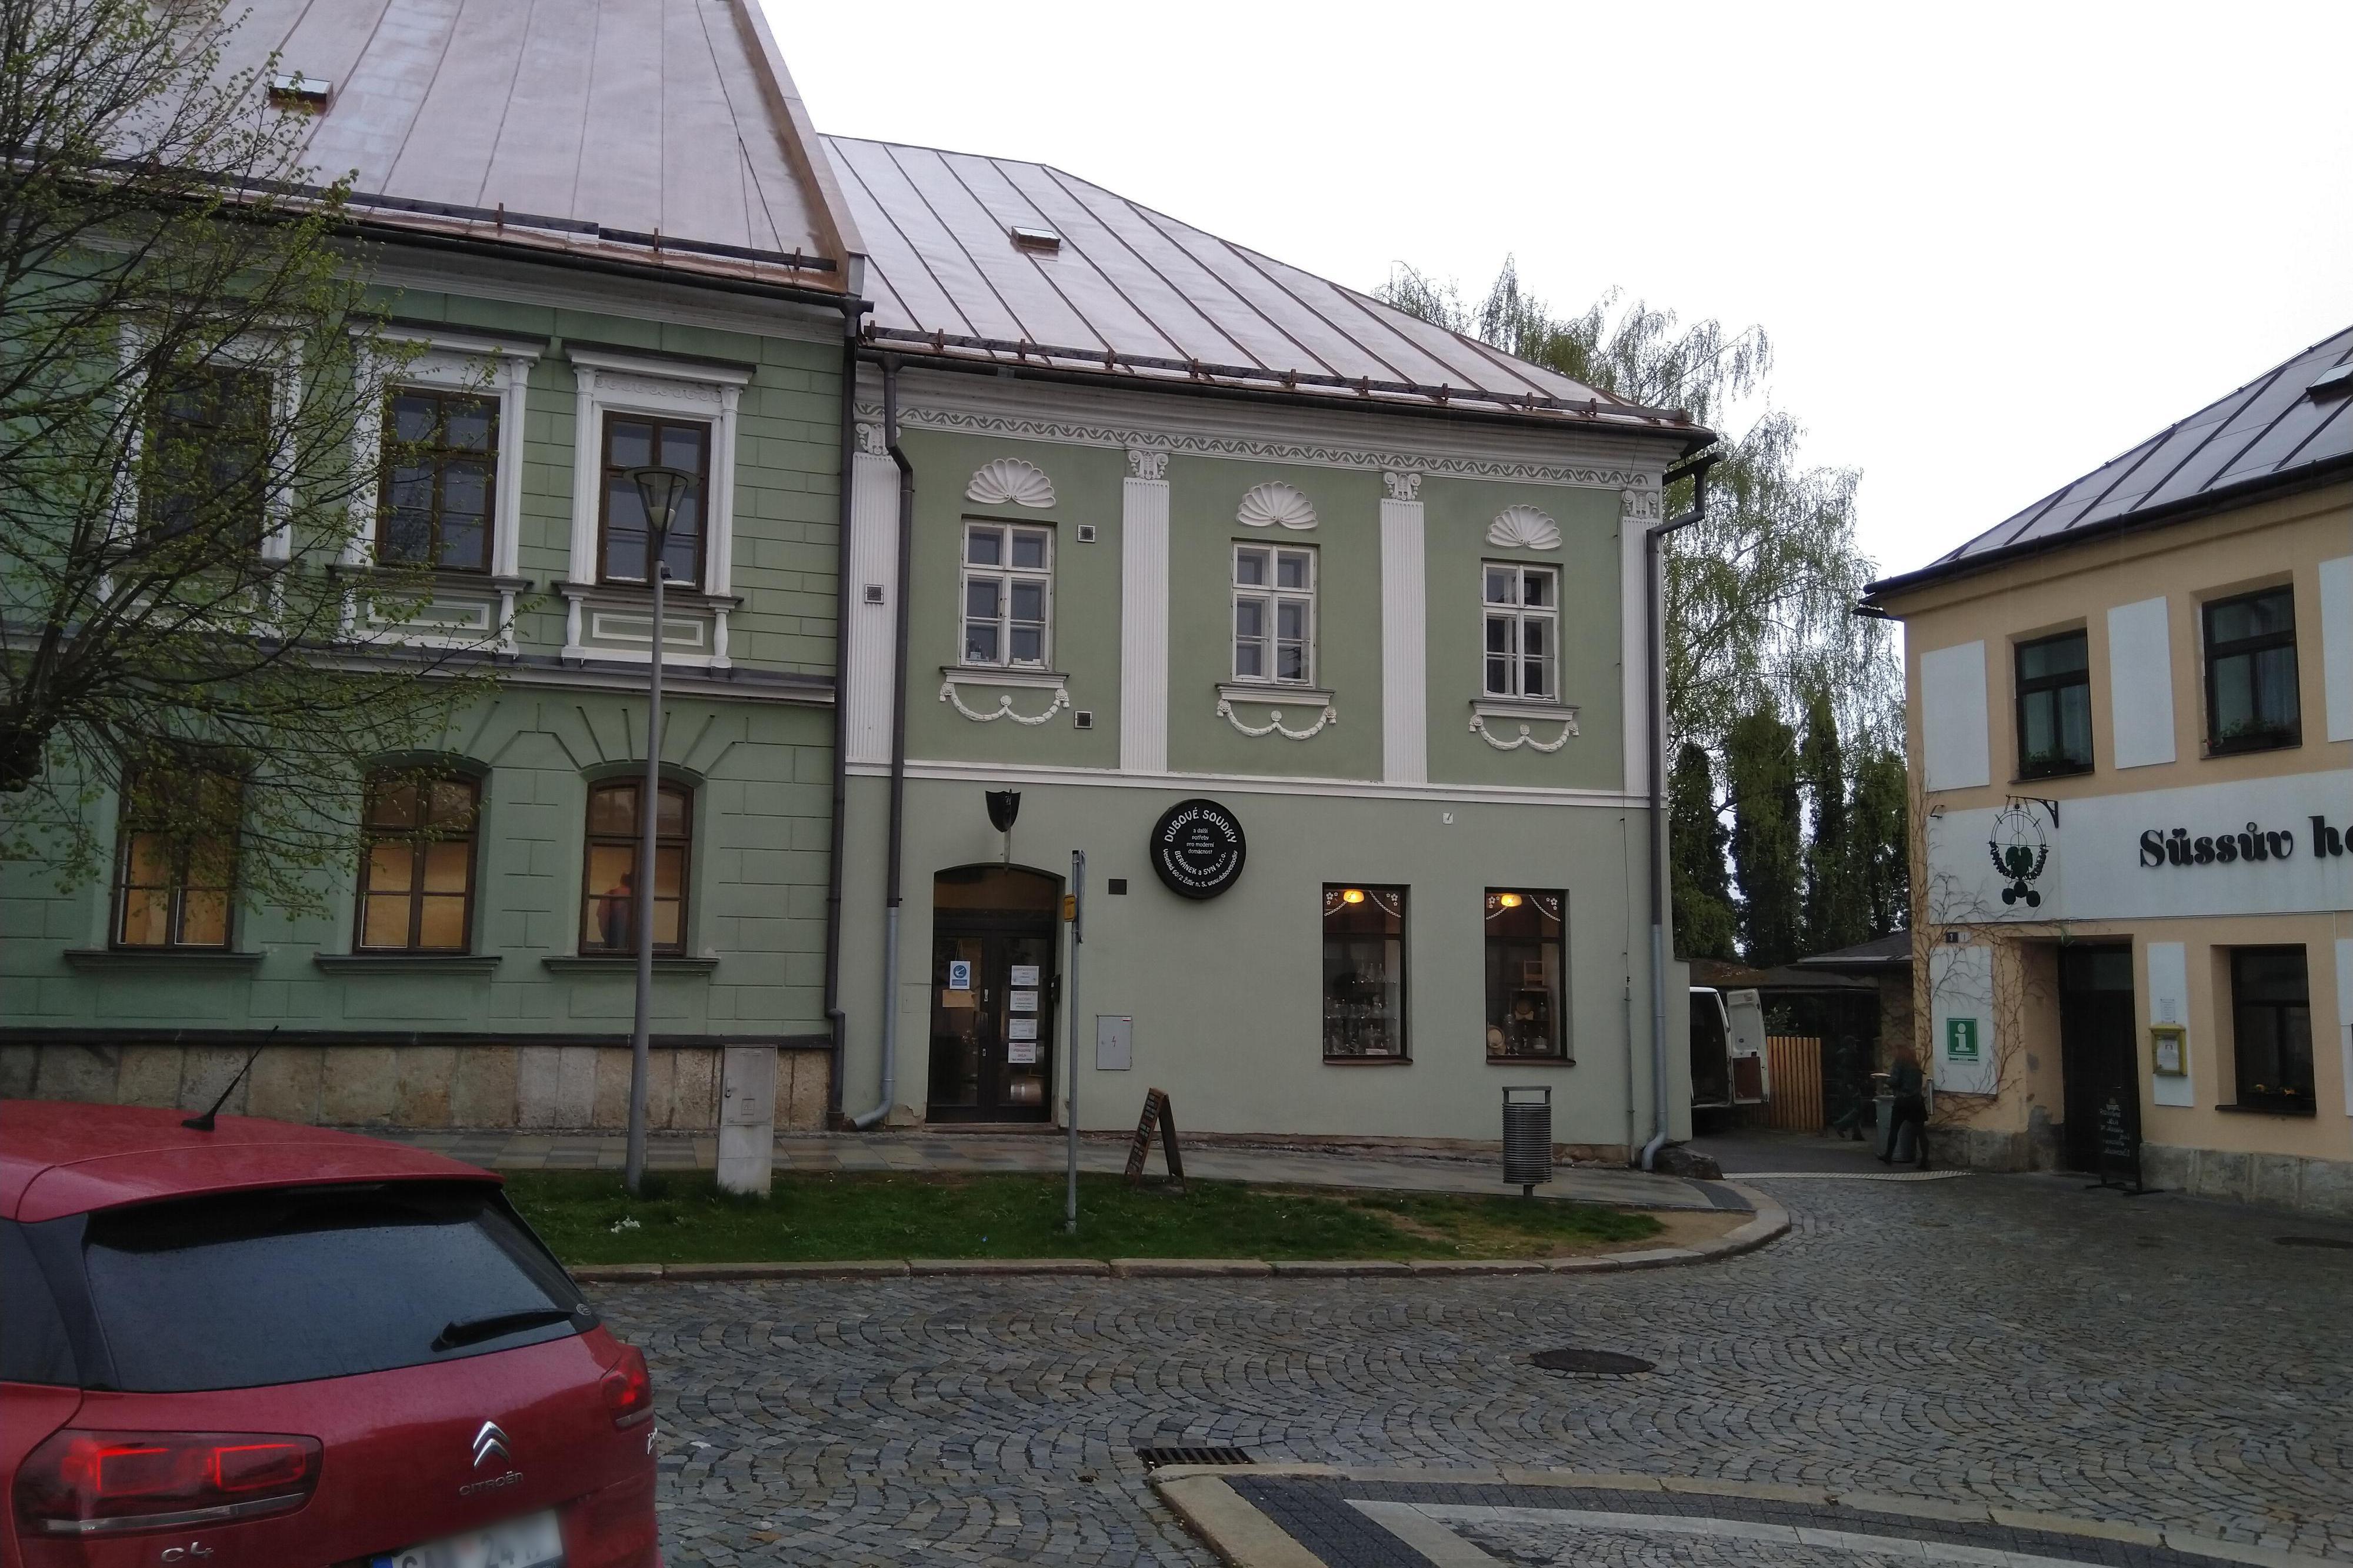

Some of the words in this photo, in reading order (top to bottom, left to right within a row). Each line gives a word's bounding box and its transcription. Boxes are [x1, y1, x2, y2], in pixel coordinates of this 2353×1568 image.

[1164, 807, 1199, 842] DUBOVÉ
[1202, 810, 1237, 843] SOUDKY
[2139, 822, 2293, 867] Süssův
[1175, 850, 1197, 875] BERÁNEK
[1203, 865, 1217, 875] SYN
[1215, 852, 1227, 868] s.r.o.
[1172, 869, 1184, 881] 60/2
[1183, 876, 1195, 886] Žďár
[161, 1541, 214, 1562] C4
